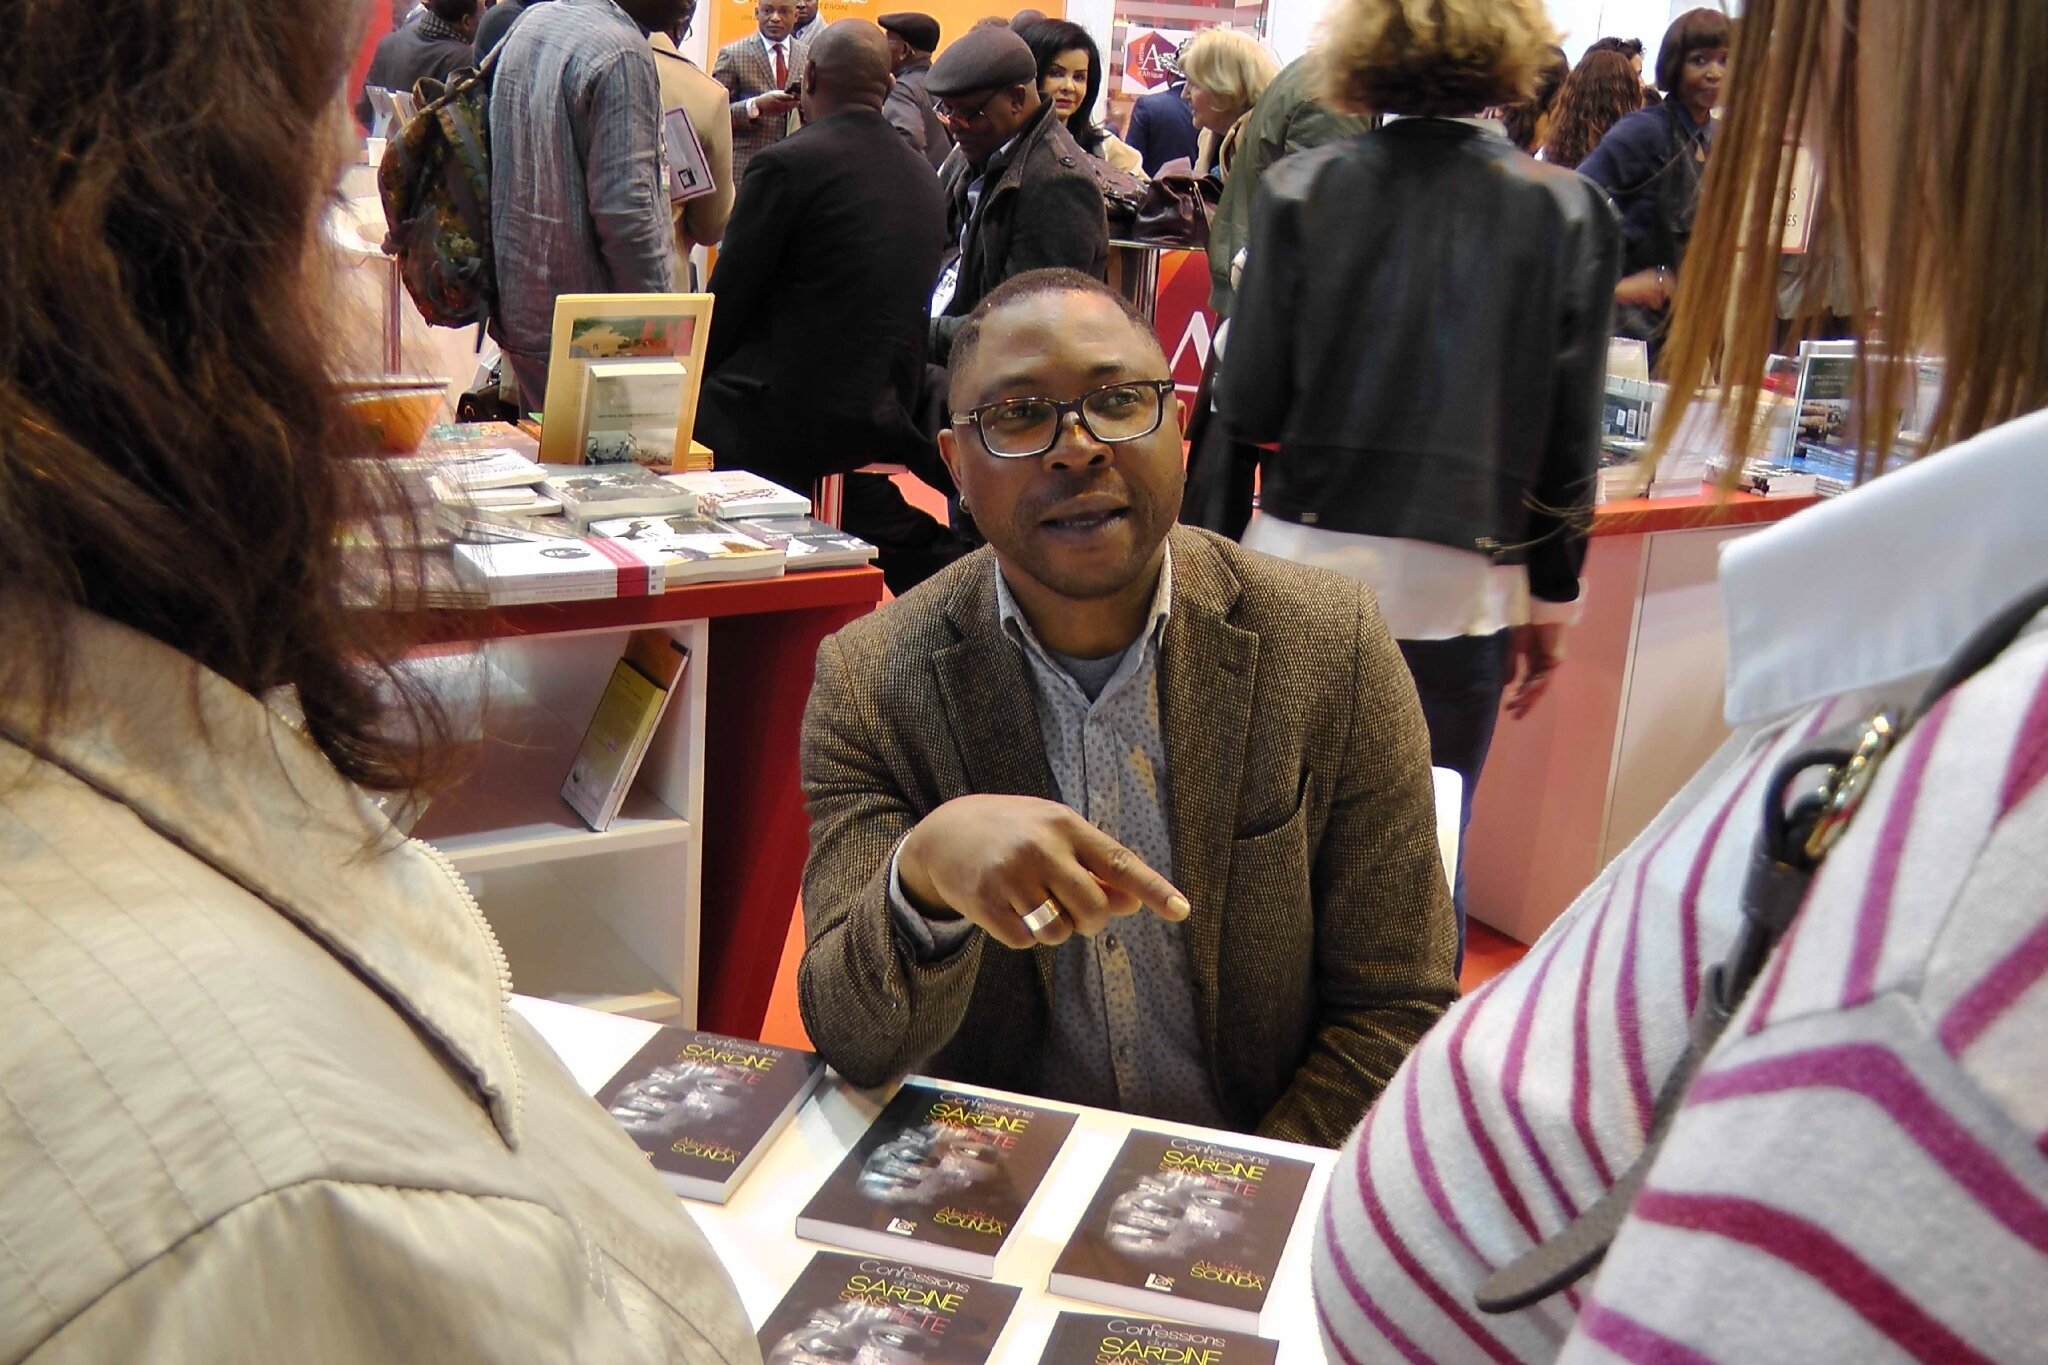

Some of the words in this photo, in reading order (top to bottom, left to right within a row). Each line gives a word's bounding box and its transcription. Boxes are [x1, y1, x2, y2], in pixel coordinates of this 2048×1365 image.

[682, 1043, 778, 1072] SARDINE
[929, 1103, 1030, 1134] SARDINE
[670, 1141, 736, 1164] SOUNDA
[1163, 1150, 1267, 1181] SARDINE
[1171, 1138, 1270, 1166] Confessions
[933, 1212, 1002, 1236] SOUNDA
[859, 1259, 970, 1293] Confessions
[1190, 1265, 1263, 1291] SOUNDA
[839, 1291, 890, 1307] SANS
[846, 1275, 965, 1313] SARDINE
[1107, 1319, 1226, 1348] Confessions
[1100, 1336, 1223, 1365] SARDINE
